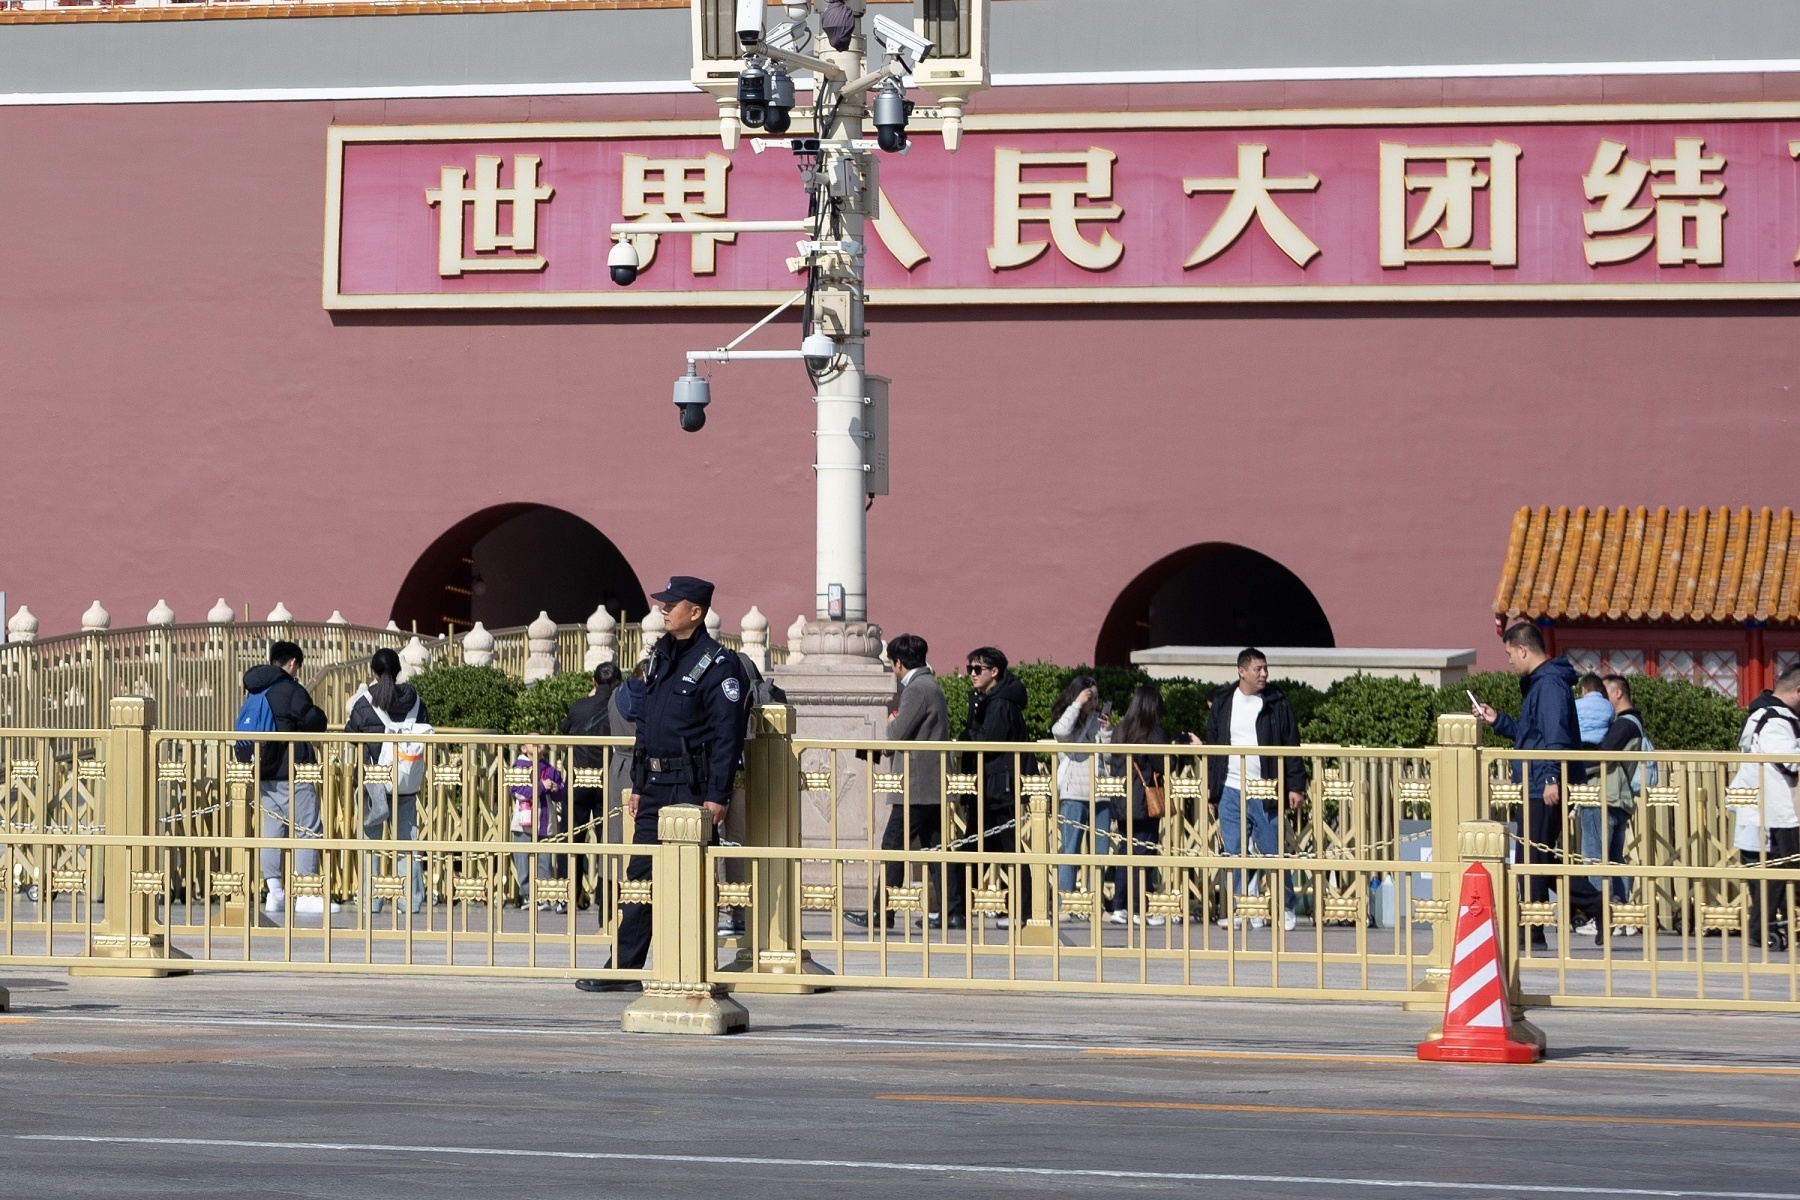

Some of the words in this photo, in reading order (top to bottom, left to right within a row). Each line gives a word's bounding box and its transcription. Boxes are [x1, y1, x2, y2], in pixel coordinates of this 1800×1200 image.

[426, 137, 1800, 276] 世界民大团结
